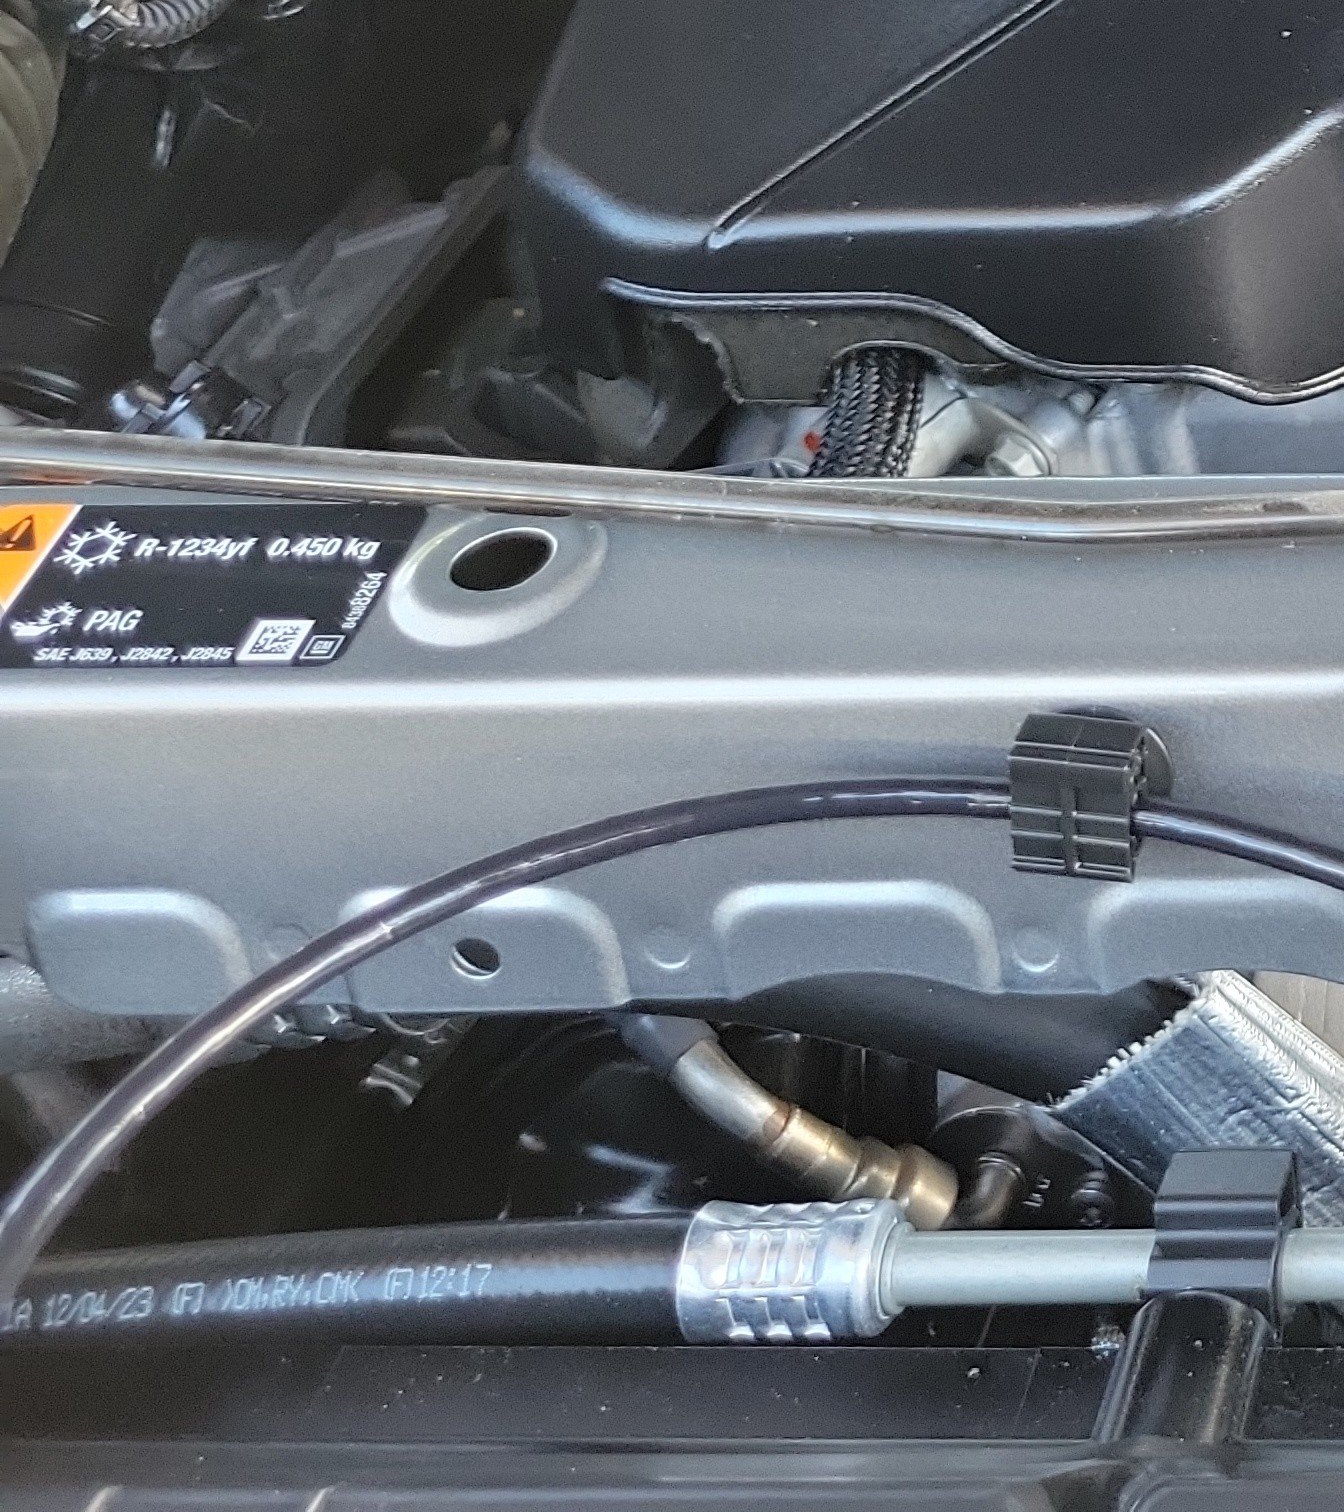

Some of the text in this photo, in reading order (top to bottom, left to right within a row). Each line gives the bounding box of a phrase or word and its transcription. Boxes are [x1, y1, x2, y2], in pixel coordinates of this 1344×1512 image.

[134, 536, 381, 561] R-1234yf 0.450 kg
[83, 609, 144, 632] PAG
[33, 647, 72, 661] SAE
[181, 647, 235, 660] J2845
[41, 1286, 156, 1327] 12/04/23
